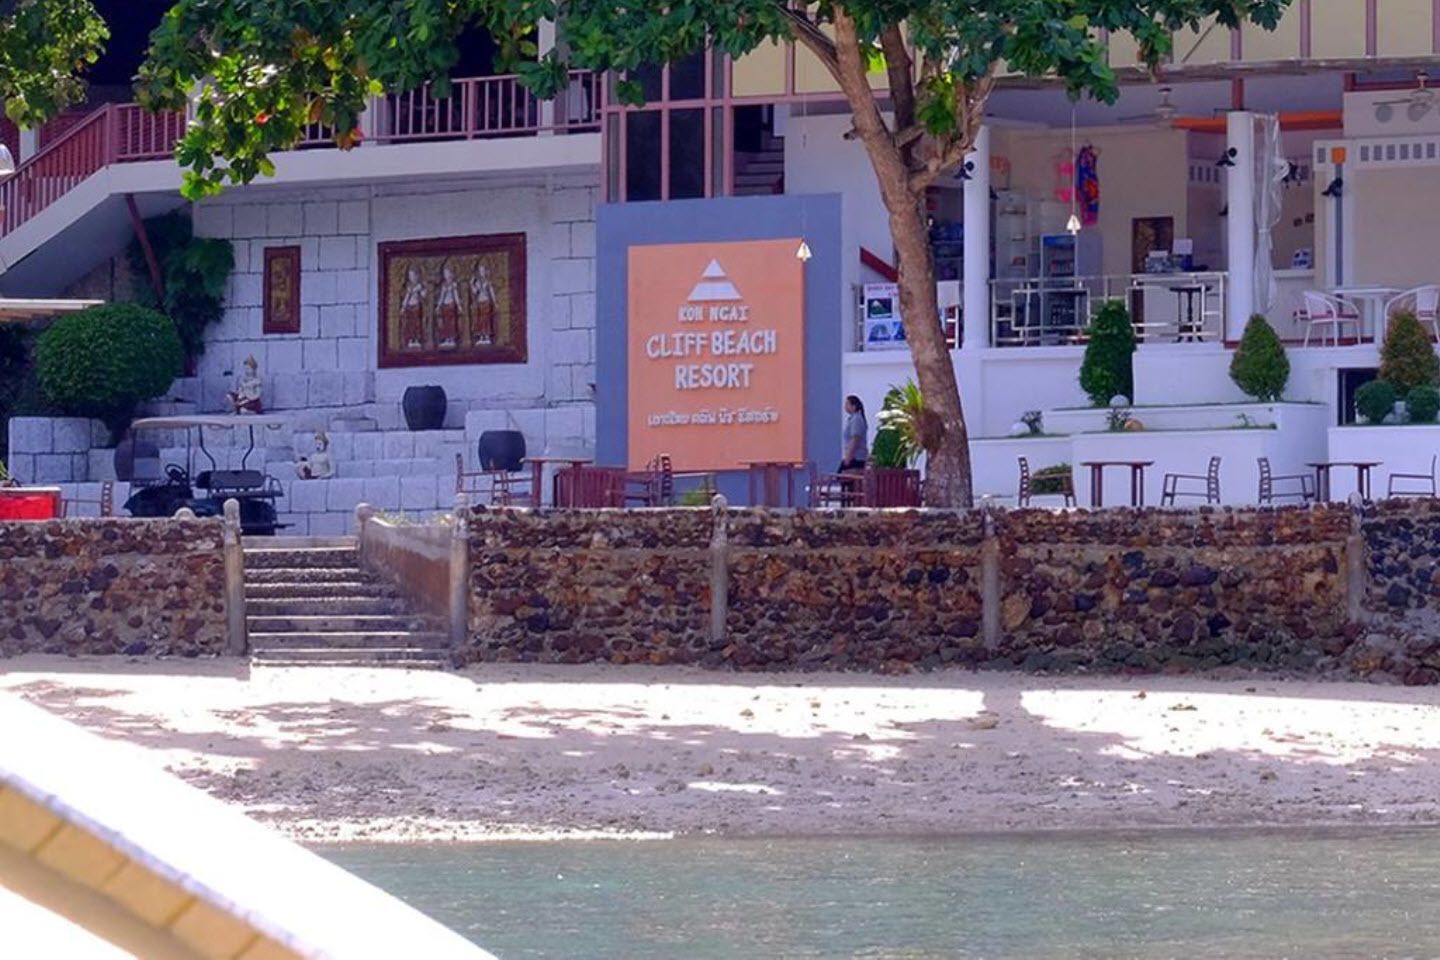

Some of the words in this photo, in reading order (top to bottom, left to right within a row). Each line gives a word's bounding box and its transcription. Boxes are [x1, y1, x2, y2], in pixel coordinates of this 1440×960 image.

[709, 305, 749, 321] NGAI
[646, 332, 708, 358] CLIFF
[711, 330, 776, 355] BEACH
[675, 363, 753, 389] RESORT
